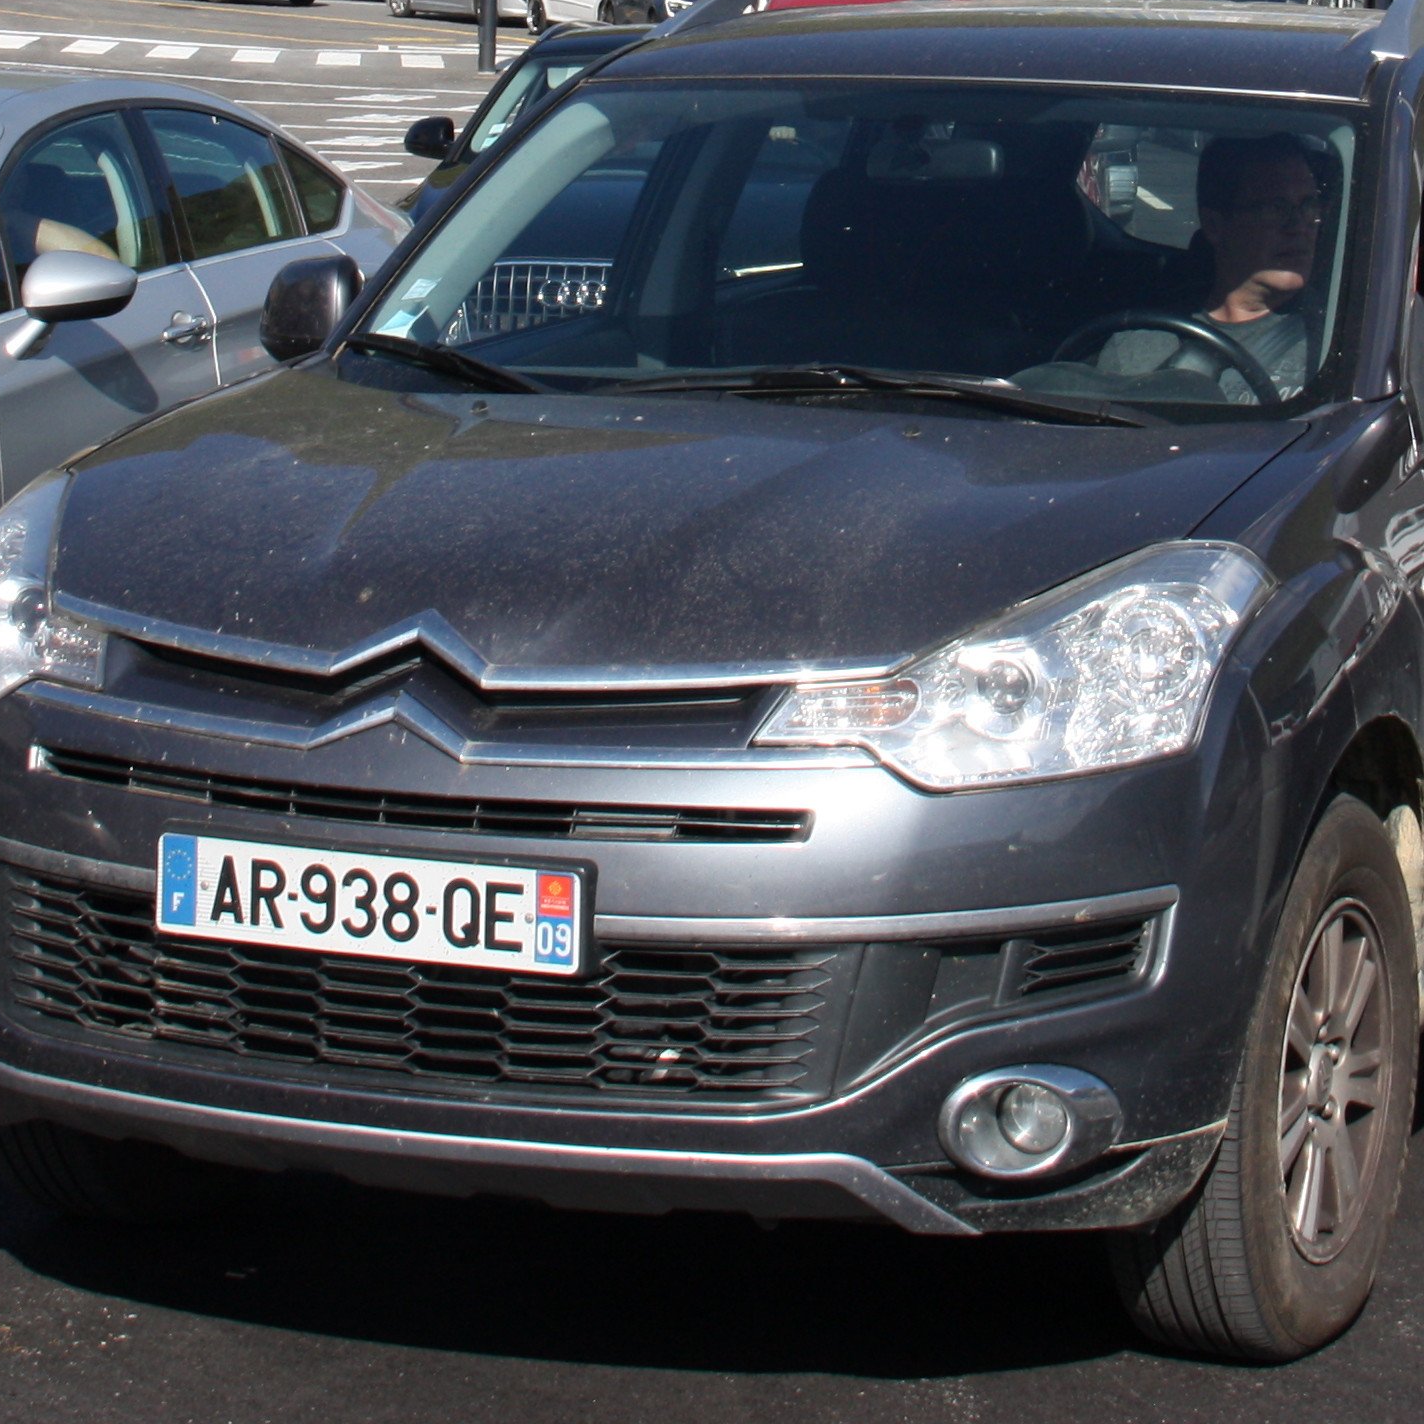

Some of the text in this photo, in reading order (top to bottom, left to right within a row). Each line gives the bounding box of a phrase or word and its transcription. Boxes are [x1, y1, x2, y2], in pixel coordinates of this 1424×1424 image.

[170, 854, 524, 953] F AR-938-QE
[536, 921, 572, 958] 09
